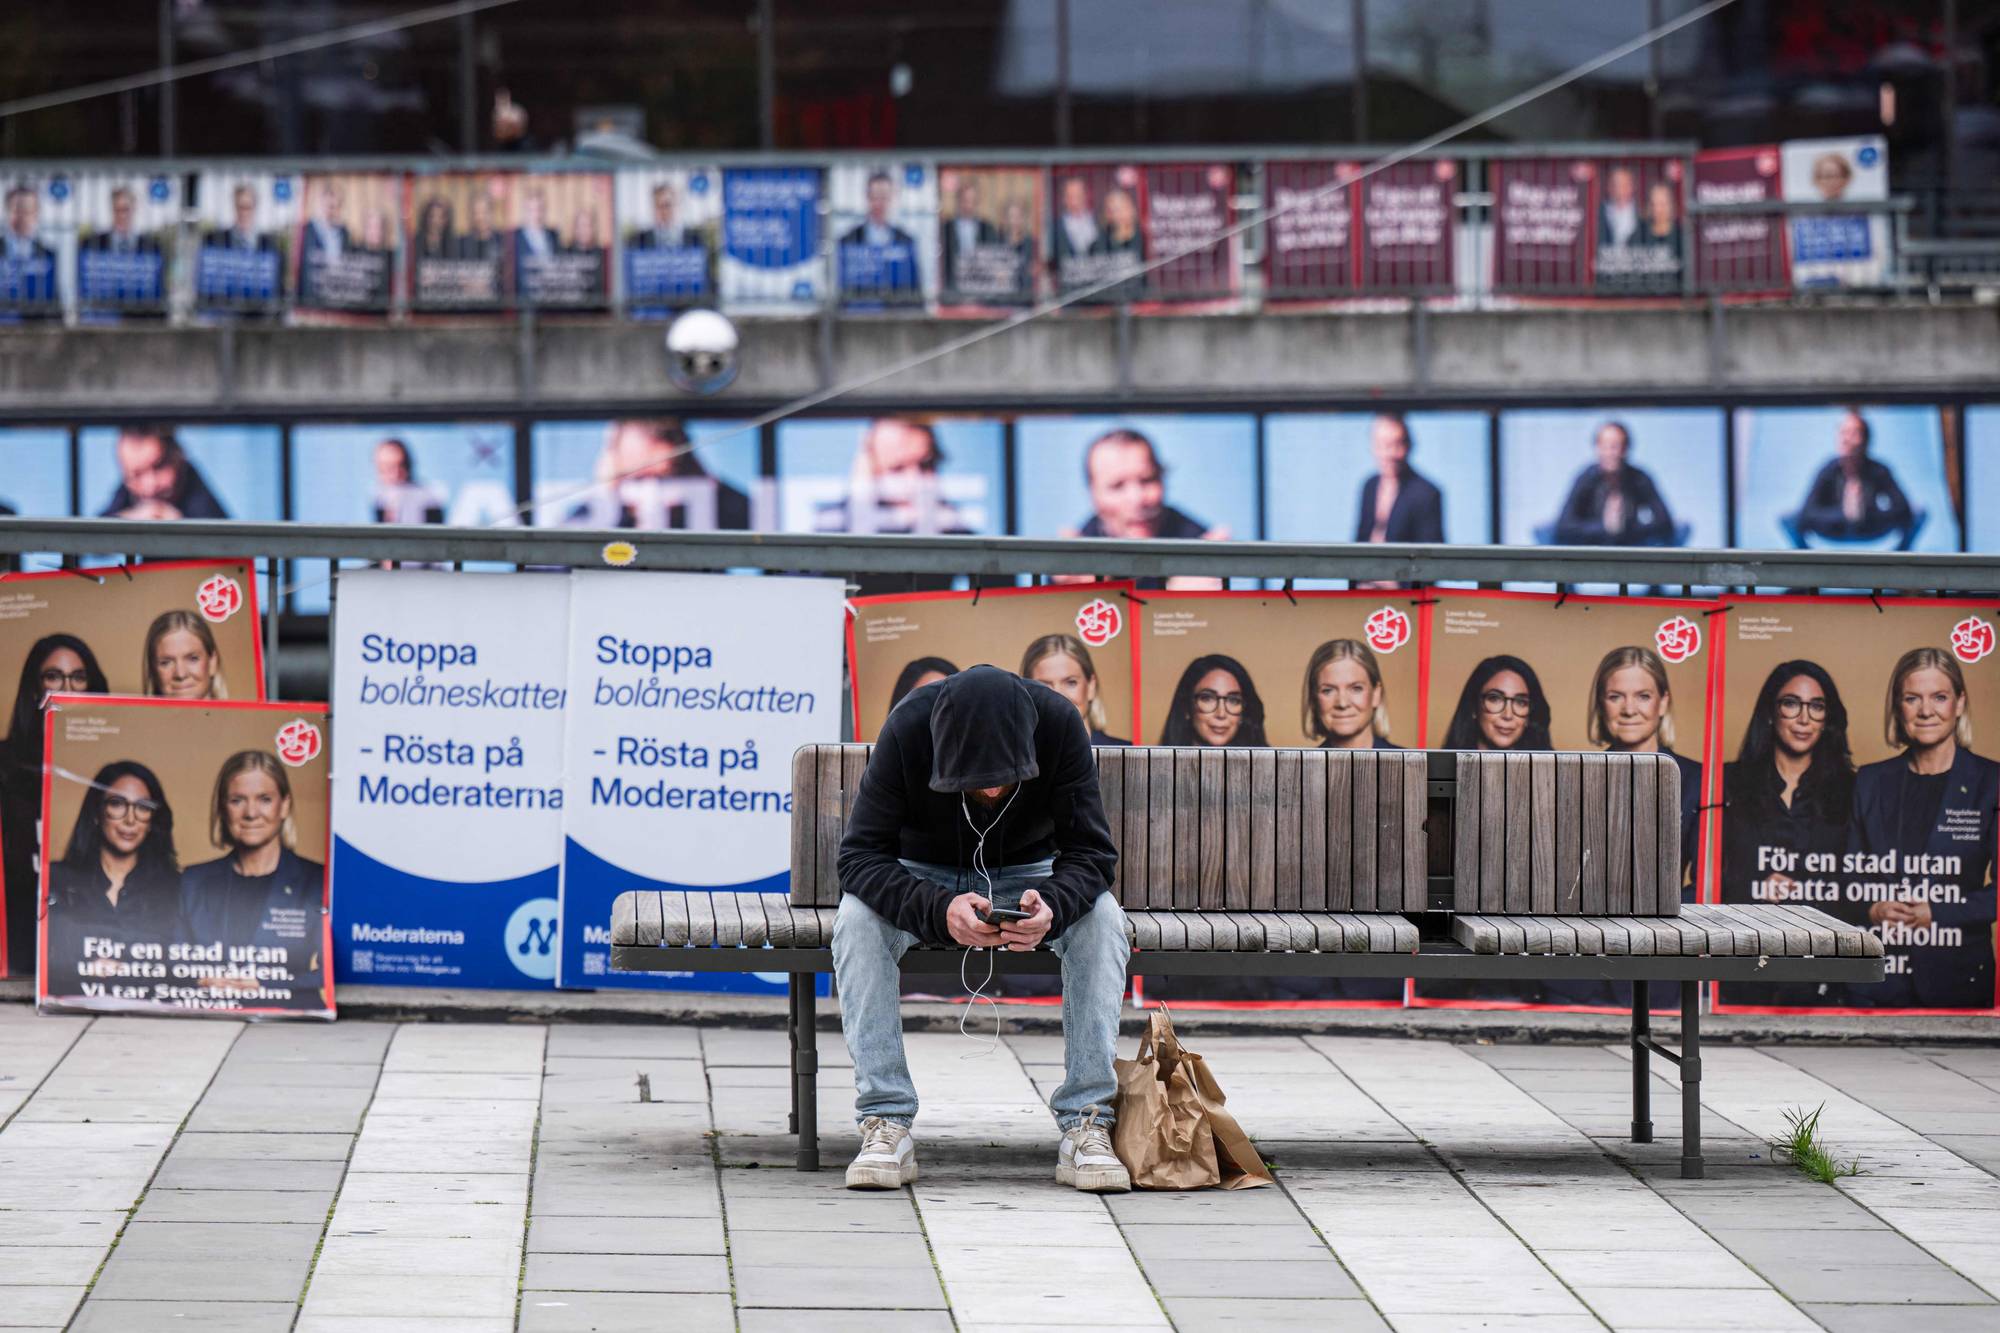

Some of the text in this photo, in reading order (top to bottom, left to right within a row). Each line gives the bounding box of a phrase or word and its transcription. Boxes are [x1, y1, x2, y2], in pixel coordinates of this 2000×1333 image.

[361, 633, 478, 673] Stoppa
[596, 635, 713, 674] Stoppa
[594, 676, 815, 714] bolåneskatten
[384, 733, 475, 766] Rösta
[485, 736, 524, 774] på
[617, 736, 709, 769] Rösta
[719, 739, 759, 777] på
[359, 775, 564, 810] Moderaterna
[1758, 846, 1961, 875] För en stad utan
[1752, 877, 1967, 904] utsatta områden.
[83, 936, 288, 963] För en stad utan
[352, 922, 465, 945] Moderaterna
[78, 961, 295, 981] utsatta områden.
[80, 982, 292, 999] Vi tar Stockholm
